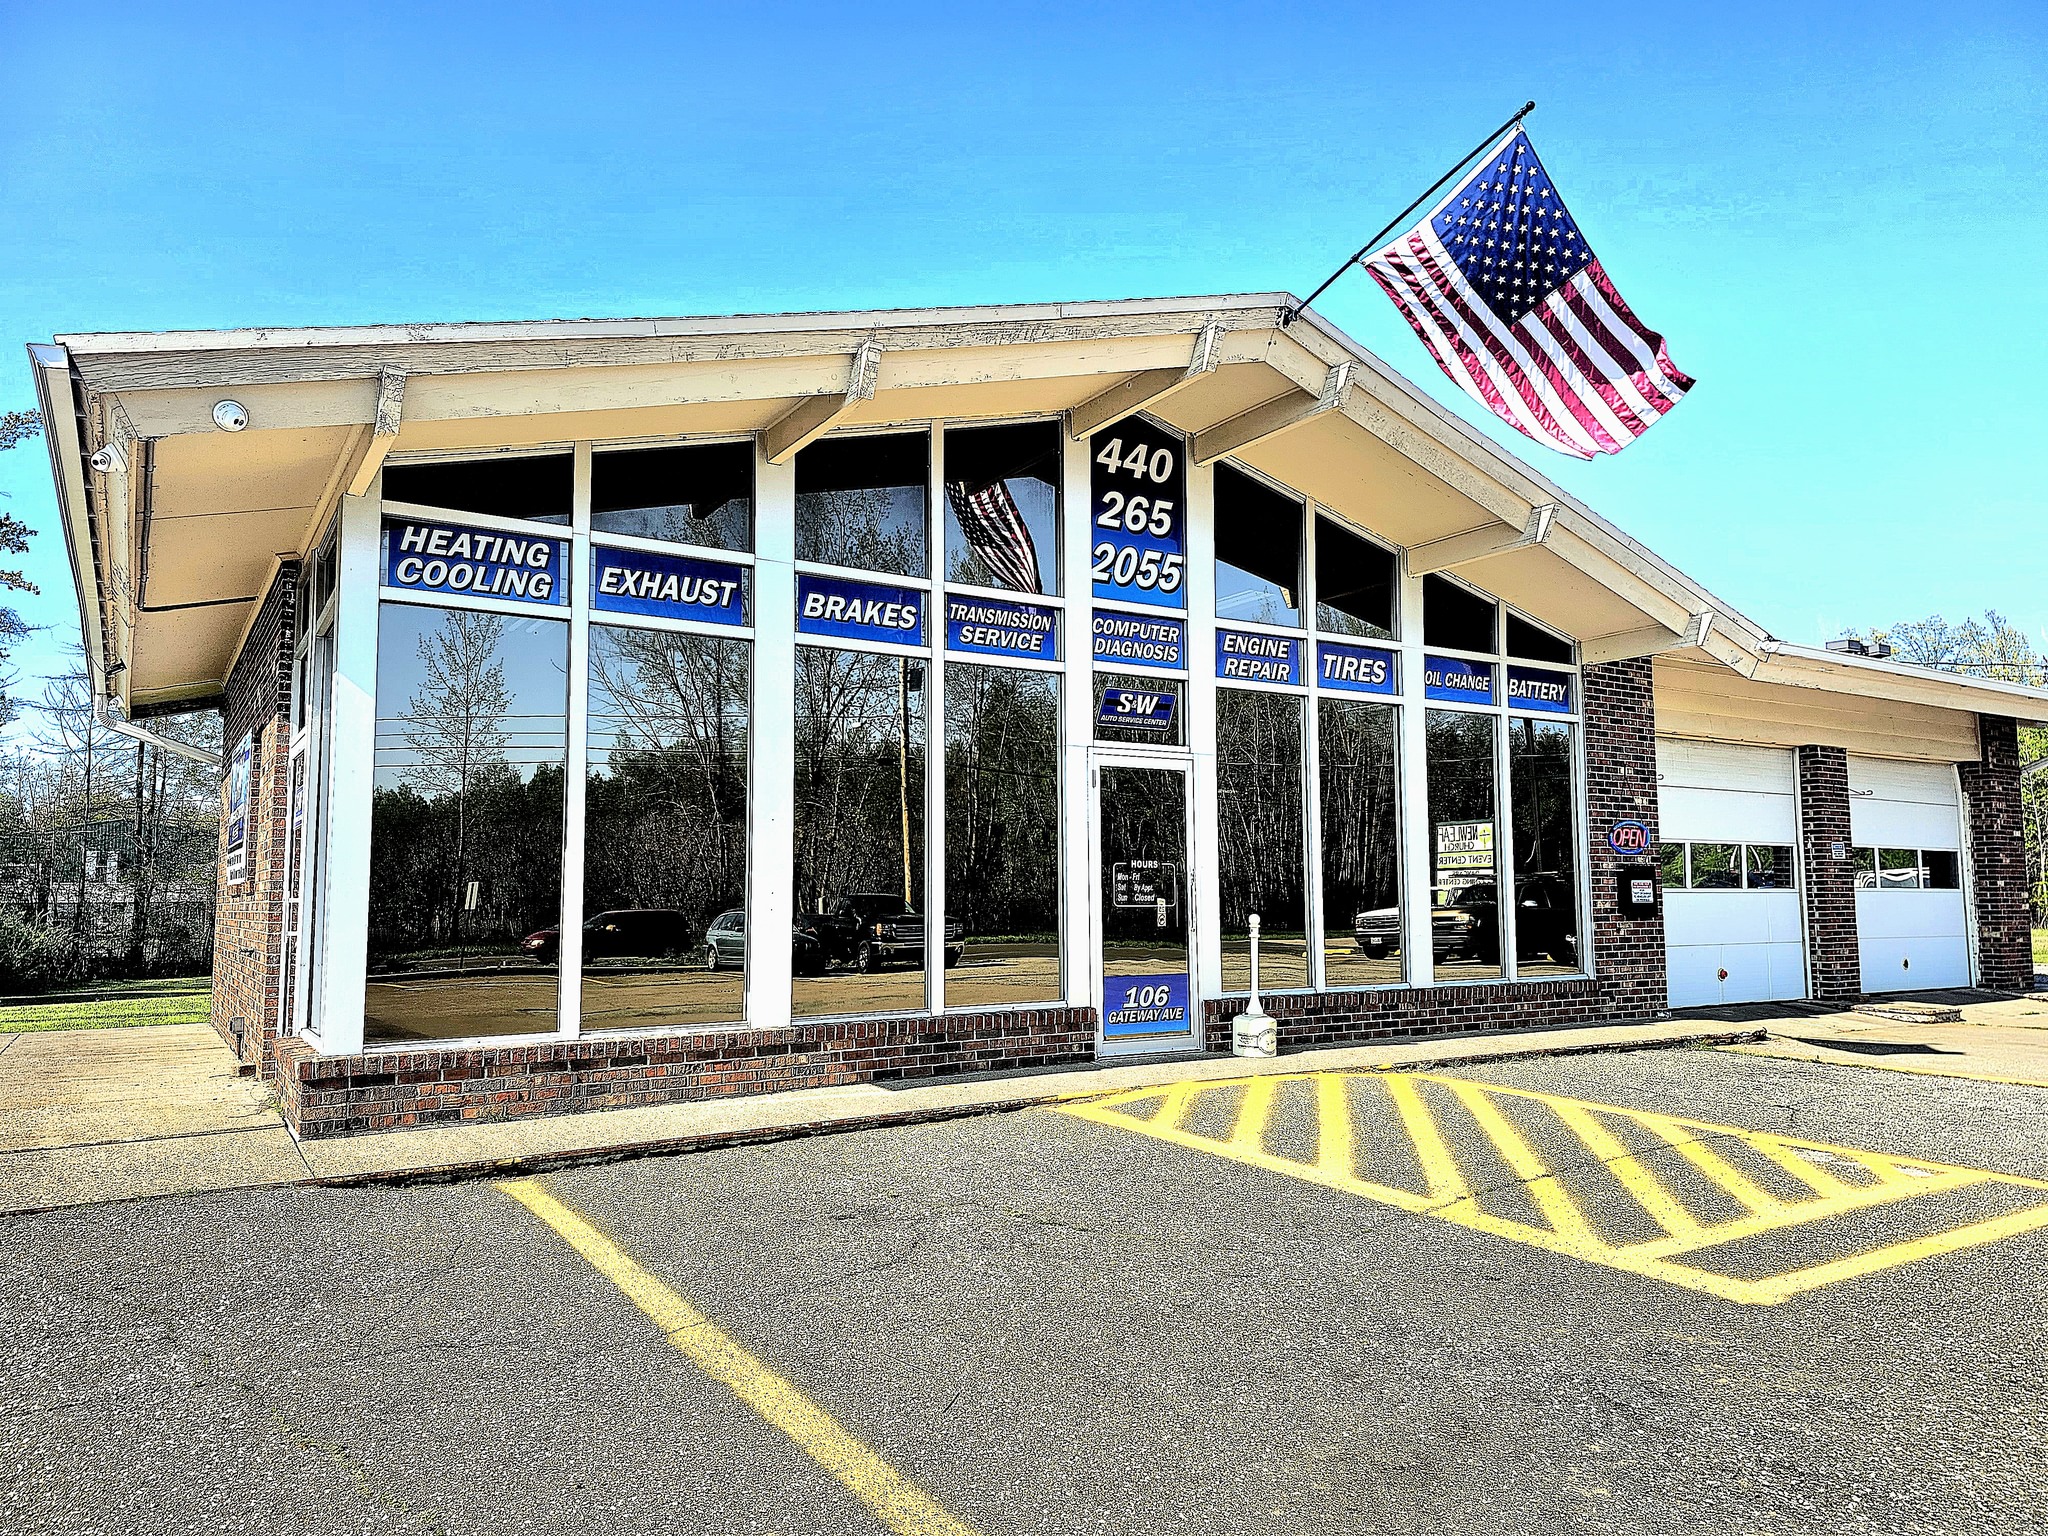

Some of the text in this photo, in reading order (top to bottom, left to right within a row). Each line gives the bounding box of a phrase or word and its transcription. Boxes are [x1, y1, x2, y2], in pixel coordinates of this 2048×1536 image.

[1096, 438, 1173, 483] 440
[1096, 491, 1174, 536] 265
[400, 525, 551, 568] HEATING
[395, 556, 553, 600] COOLING
[1092, 542, 1183, 592] 2055
[598, 566, 738, 607] EXHAUST
[803, 592, 918, 630] BRAKES
[950, 604, 1052, 632] TRANSMISSION
[959, 626, 1044, 652] SERVICE
[1092, 617, 1180, 643] COMPUTER
[1094, 637, 1179, 662] DIAGNOSIS
[1223, 634, 1291, 660] ENGINE
[1224, 657, 1291, 682] REPAIR
[1323, 653, 1388, 684] TIRES
[1425, 670, 1490, 692] OIL CHANGE
[1508, 677, 1567, 702] BATTERY
[1101, 714, 1167, 726] AUTO SERVICE CENTER
[1612, 828, 1647, 848] OPEN
[1131, 860, 1158, 868] HOURS
[1134, 893, 1155, 901] Closed
[1123, 985, 1170, 1008] 106
[1109, 1008, 1184, 1023] GATEWAY AVE
